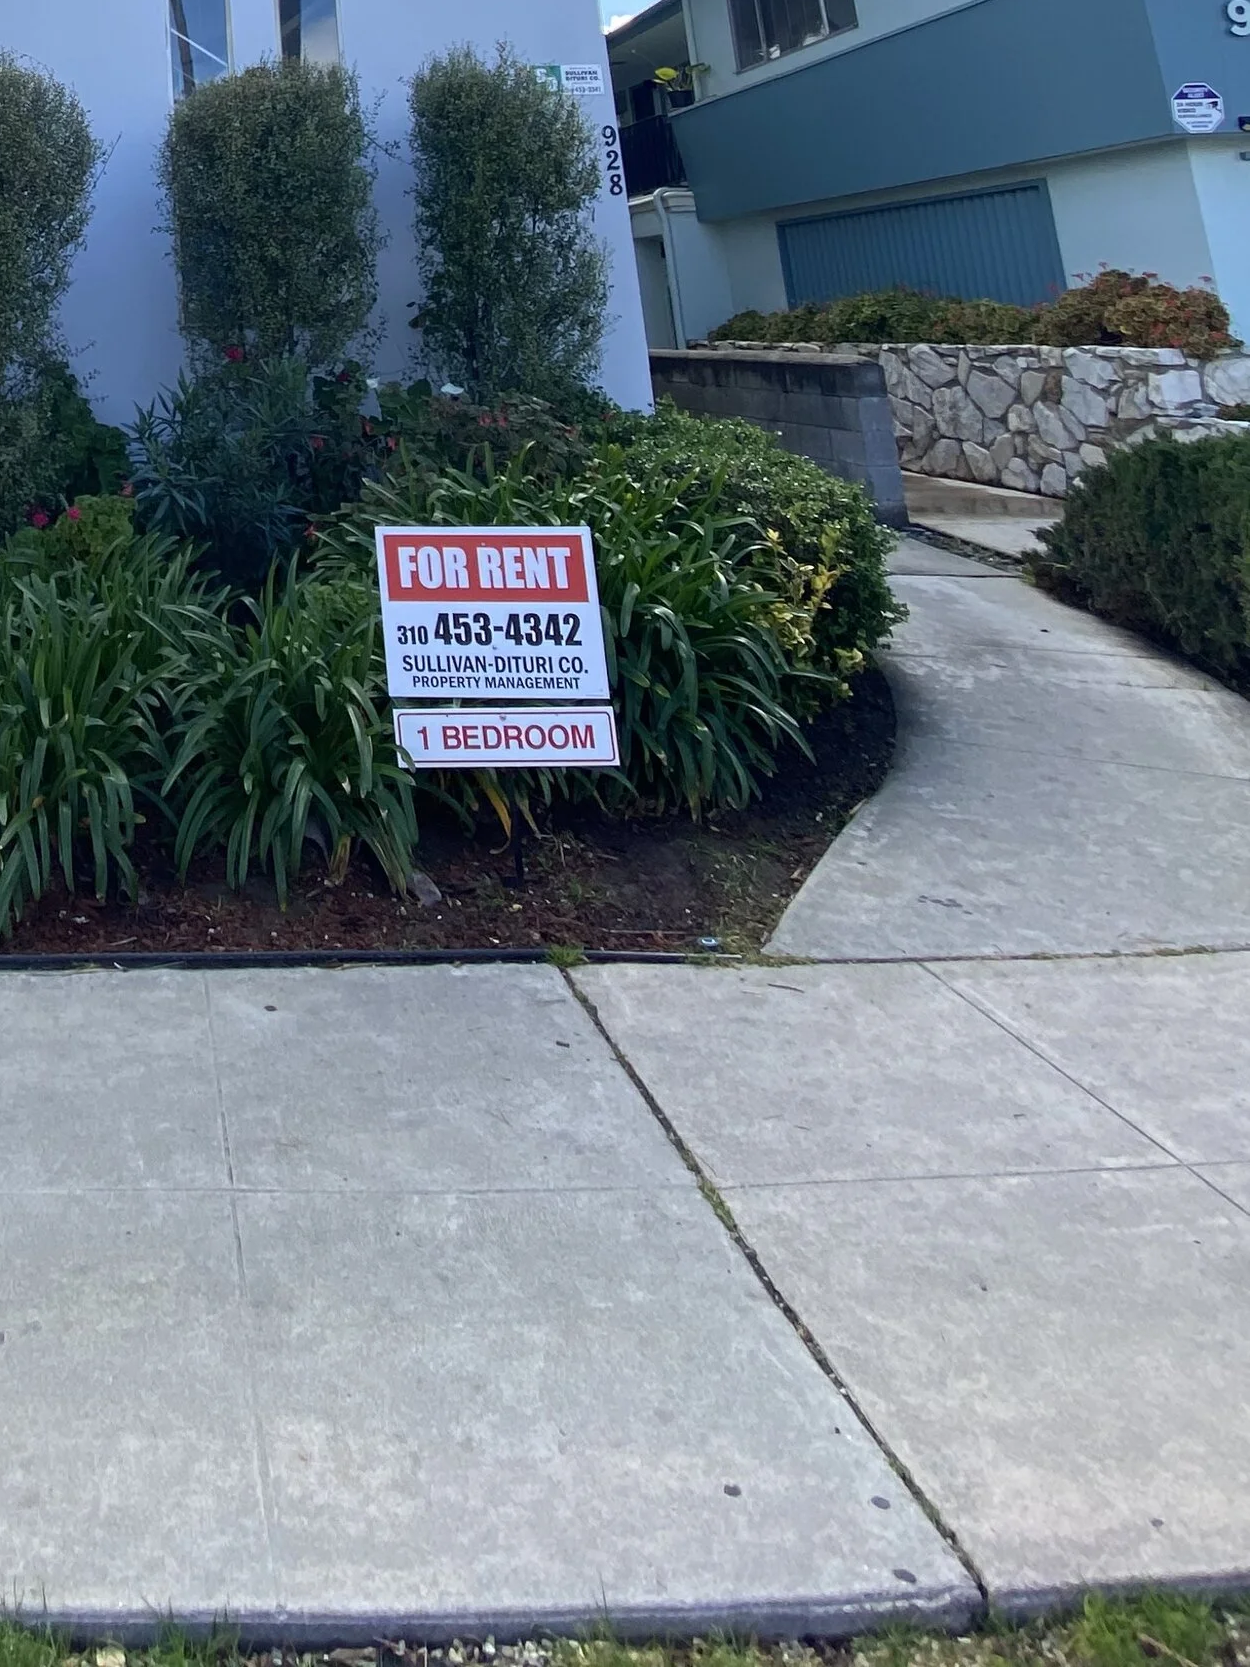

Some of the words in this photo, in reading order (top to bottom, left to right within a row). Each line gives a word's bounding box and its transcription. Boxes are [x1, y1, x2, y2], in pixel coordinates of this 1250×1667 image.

[601, 125, 623, 196] 928
[397, 546, 470, 590] FOR
[476, 546, 571, 590] RENT
[397, 625, 429, 645] 310
[434, 612, 583, 647] 453-4342
[402, 654, 553, 675] SULLIVAN-DITURI
[558, 656, 589, 675] CO.
[412, 675, 481, 689] PROPERTY
[485, 676, 580, 690] MANAGEMENT
[417, 725, 429, 750] 1
[442, 724, 596, 750] BEDROOM
